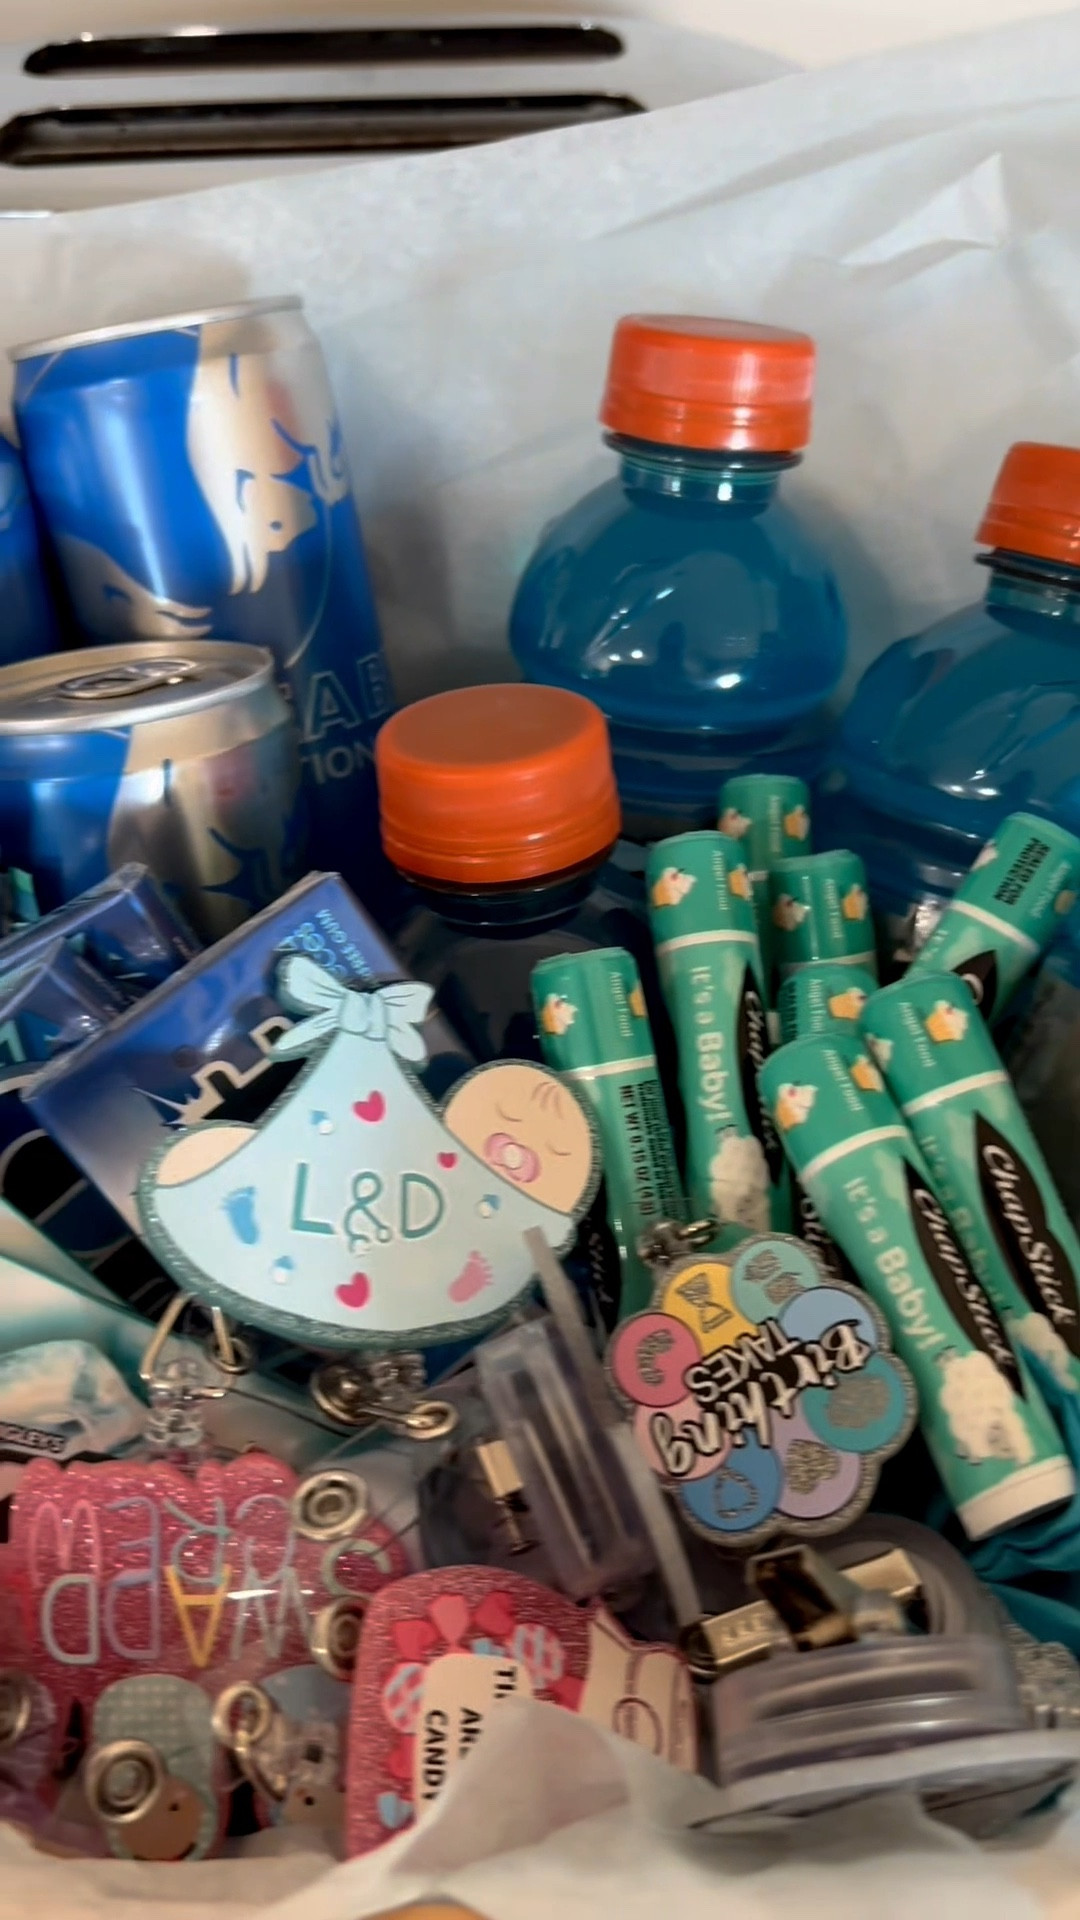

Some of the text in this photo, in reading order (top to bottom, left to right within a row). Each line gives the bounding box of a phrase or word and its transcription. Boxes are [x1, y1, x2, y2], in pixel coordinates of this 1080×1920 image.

[697, 1031, 735, 1122] Baby!
[291, 1162, 444, 1255] L&D
[842, 1176, 947, 1353] It's a Baby!
[912, 1188, 1014, 1366] ChapStick
[982, 1143, 1077, 1324] ChapStick
[648, 1318, 872, 1478] Birthing
[685, 1318, 800, 1404] TAKES
